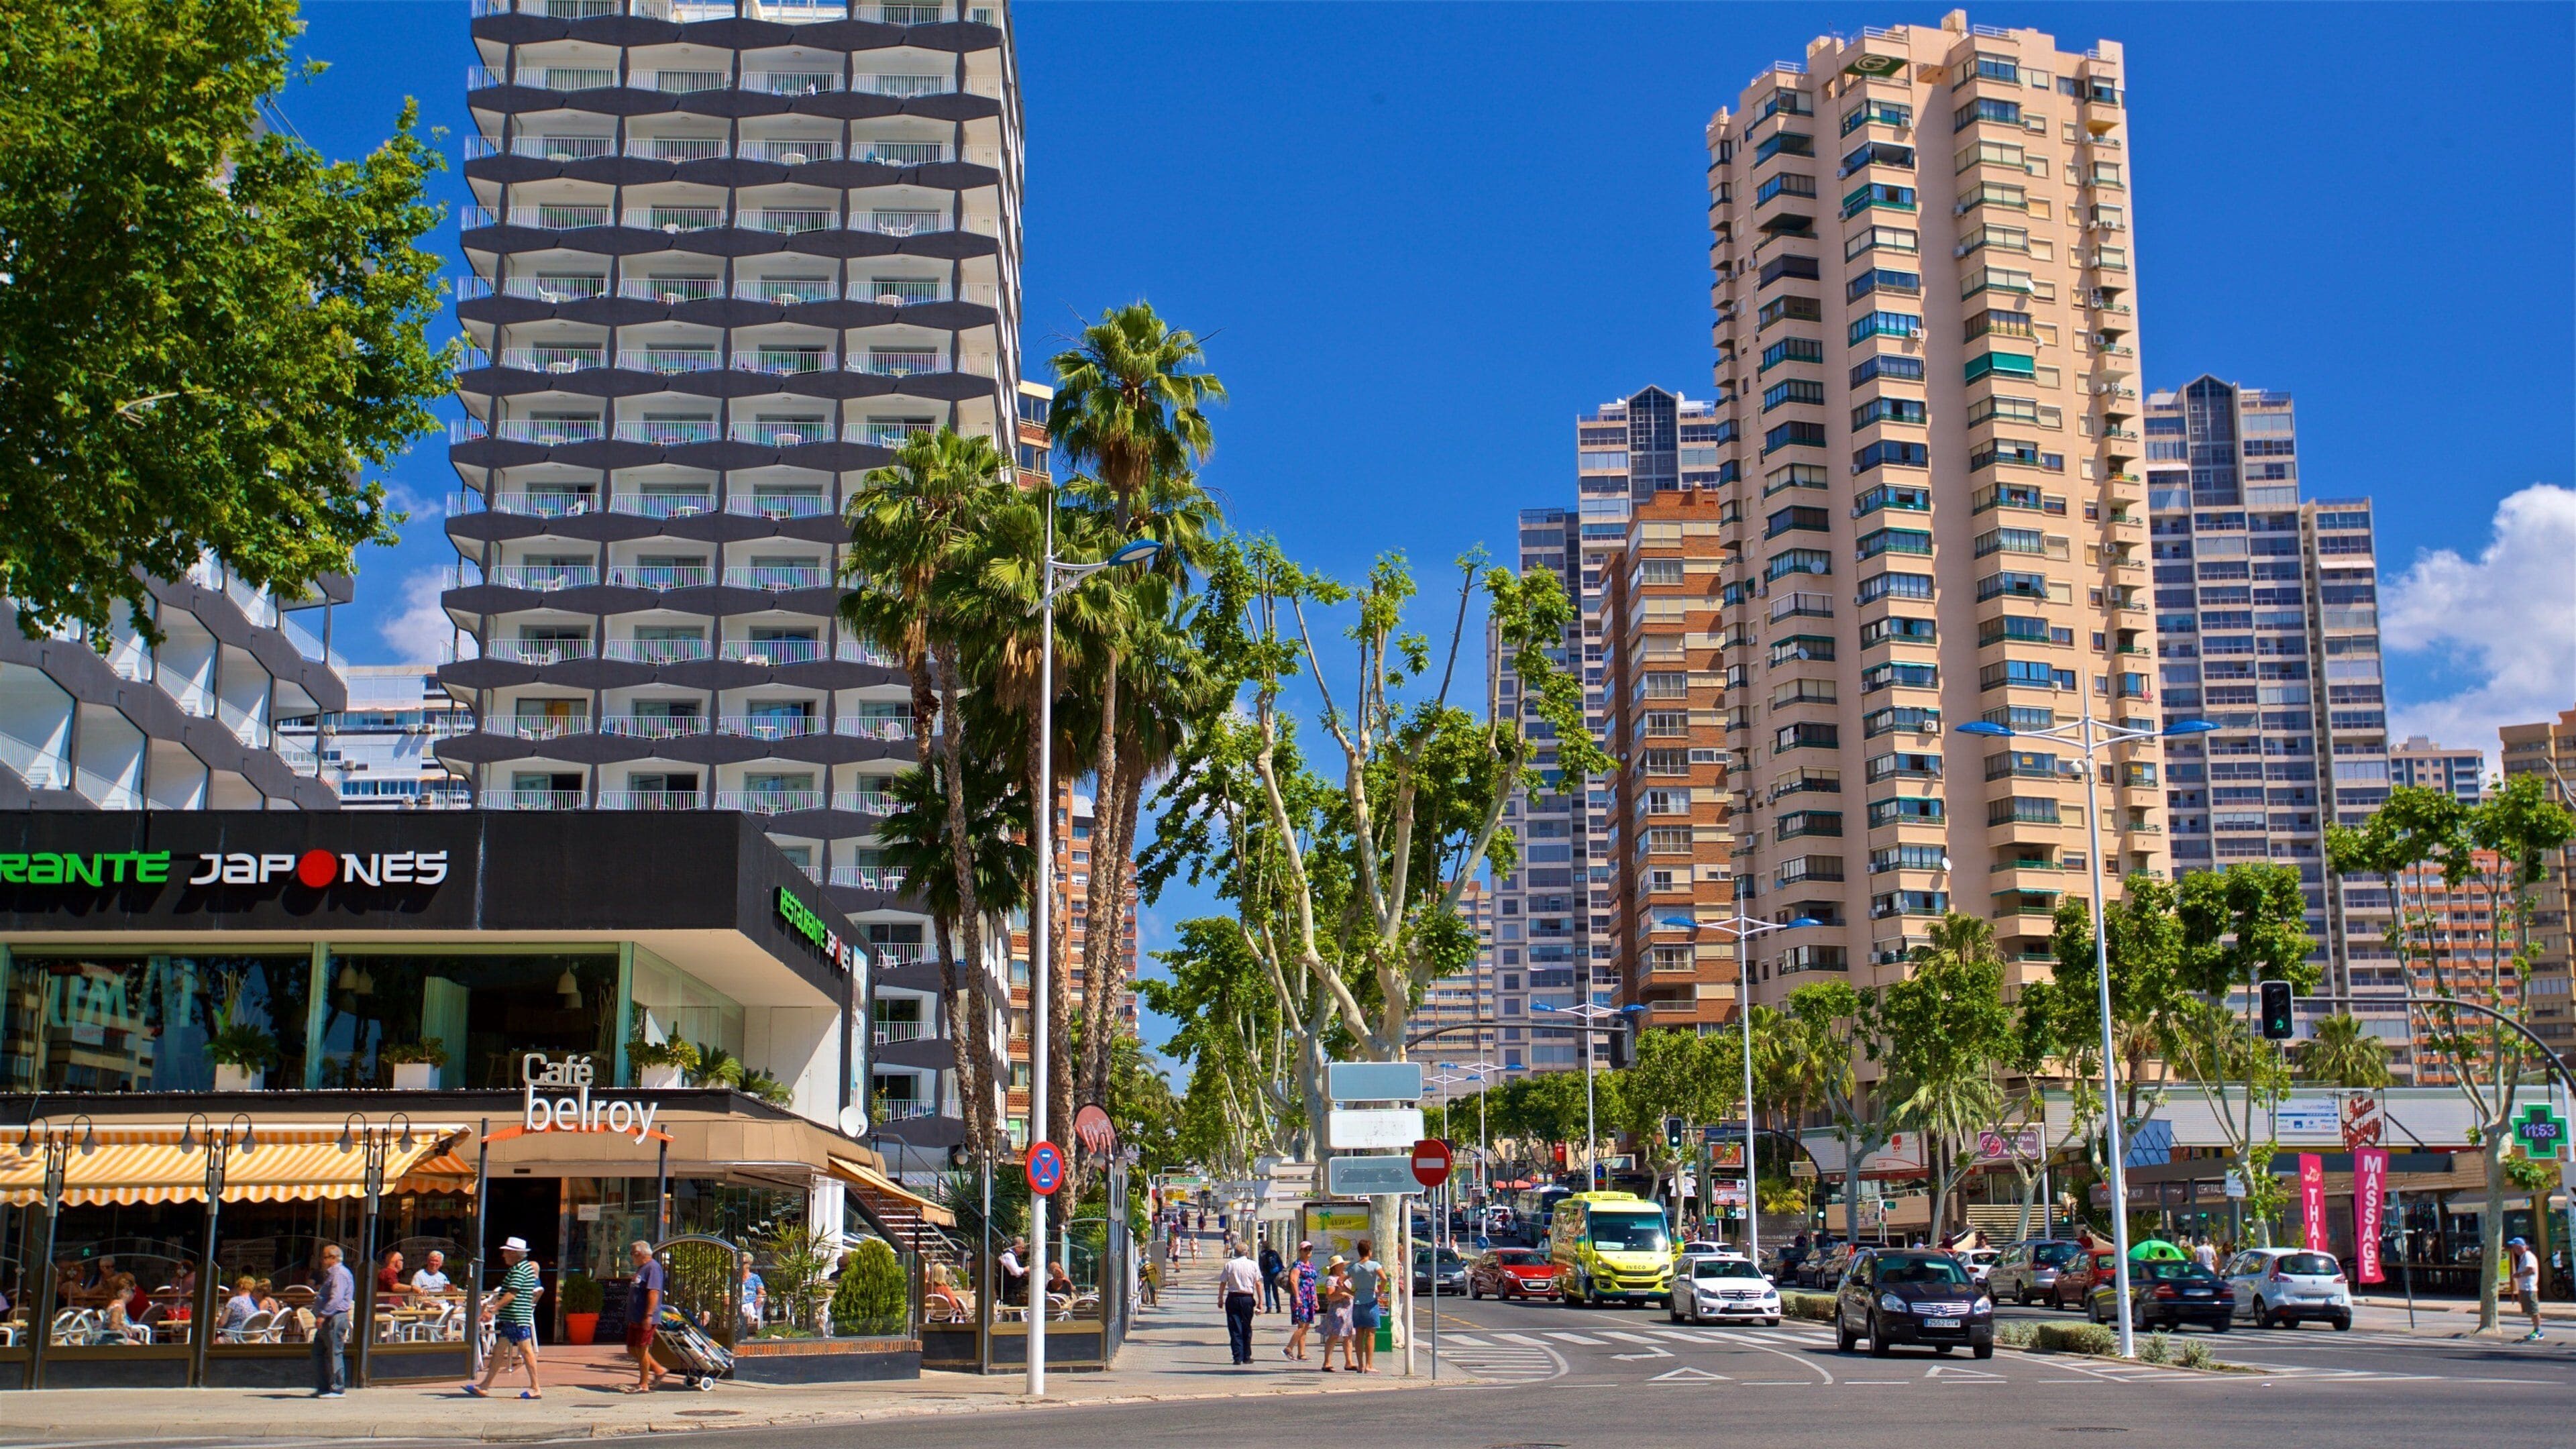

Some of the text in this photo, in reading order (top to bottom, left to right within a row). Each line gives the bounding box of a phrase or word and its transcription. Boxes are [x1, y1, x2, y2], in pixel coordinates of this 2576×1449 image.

[780, 885, 826, 949] RESTAURANTE
[523, 1053, 594, 1085] Café
[523, 1084, 659, 1145] belroy
[2522, 1124, 2557, 1138] 11:53
[2308, 1187, 2320, 1252] THAI
[2362, 1155, 2382, 1277] MASSAGE
